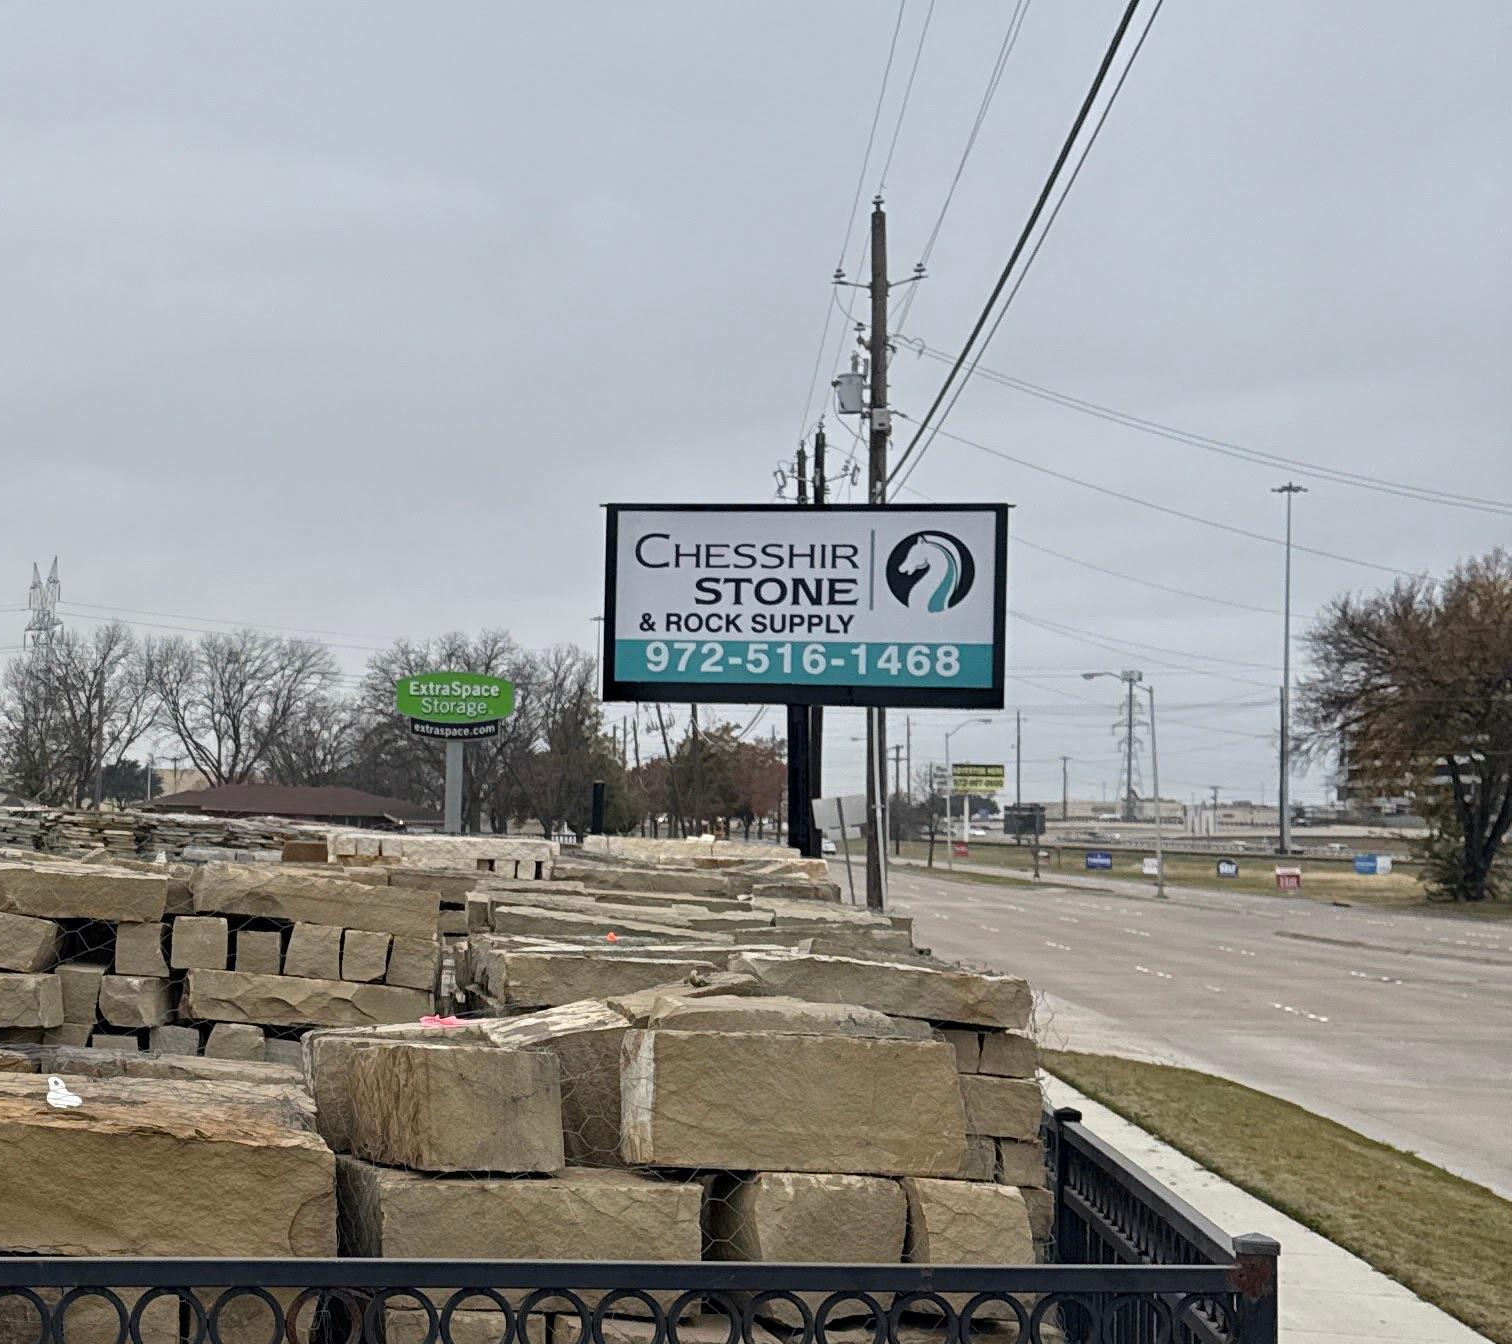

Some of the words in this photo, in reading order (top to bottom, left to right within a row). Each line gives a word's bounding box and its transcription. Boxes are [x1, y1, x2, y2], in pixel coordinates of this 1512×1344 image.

[635, 533, 860, 569] CHESSHIR
[694, 577, 859, 605] STONE
[639, 612, 656, 633] &
[665, 612, 743, 633] ROCK
[750, 613, 855, 634] SUPPLY
[645, 640, 961, 678] 972-516-1468
[409, 681, 500, 699] ExtraSpace
[421, 697, 487, 717] Storage
[414, 722, 496, 737] extraspace.com
